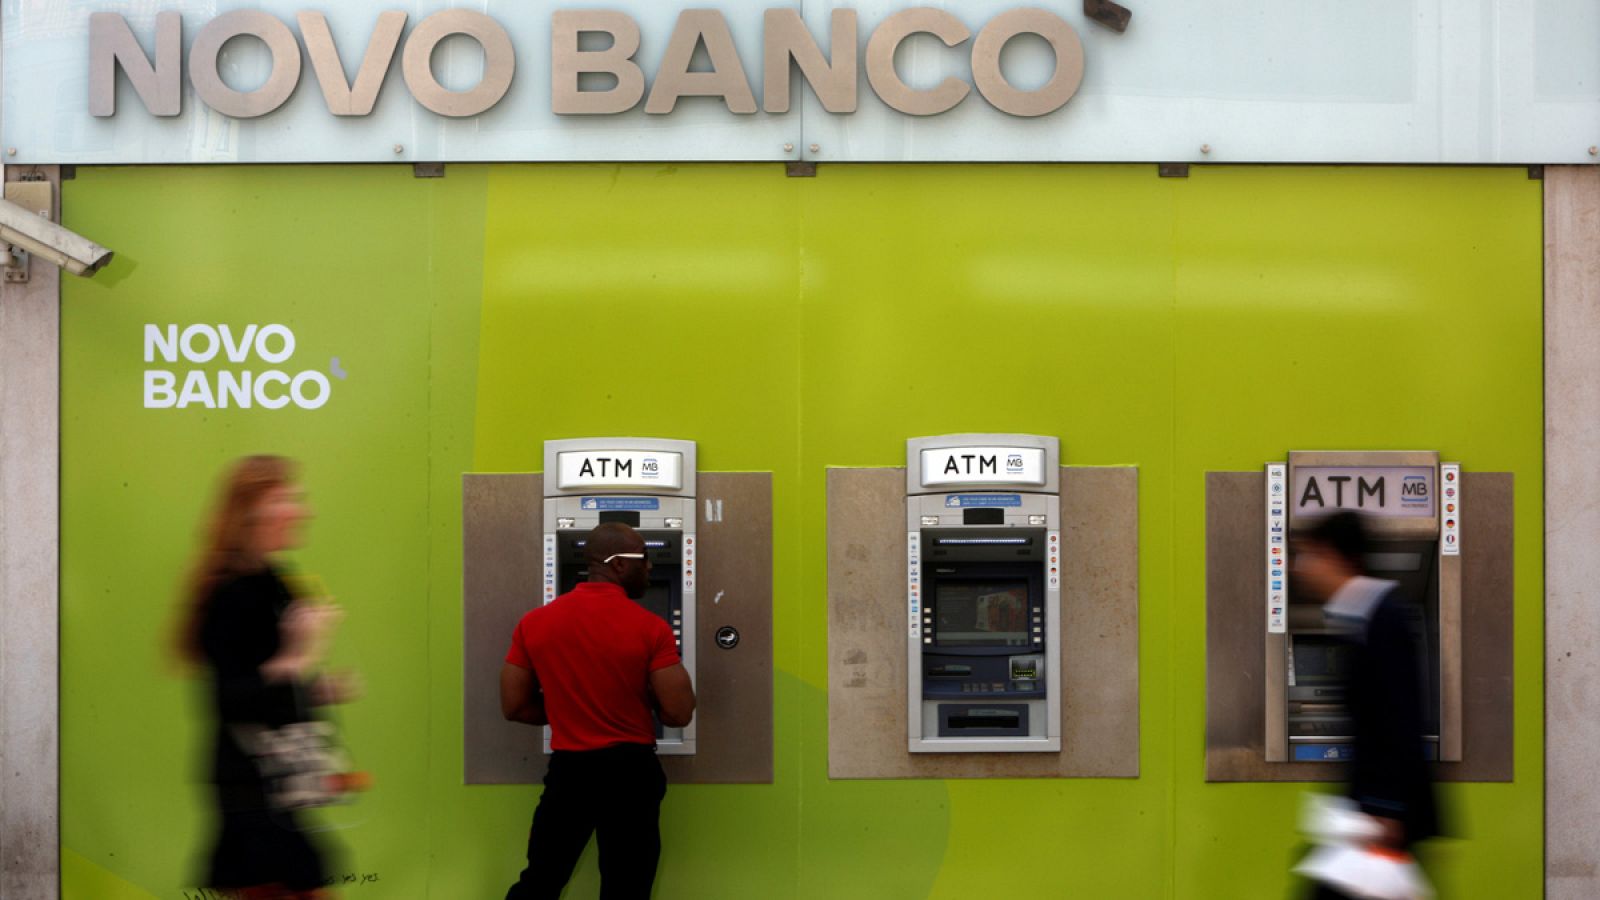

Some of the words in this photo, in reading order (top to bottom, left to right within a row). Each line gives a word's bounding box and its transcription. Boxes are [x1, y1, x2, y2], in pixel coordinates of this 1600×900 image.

[88, 8, 515, 118] NOVO
[551, 7, 1084, 116] BANCO
[144, 323, 296, 363] NOVO
[143, 370, 331, 409] BANCO
[579, 457, 632, 478] ATM
[944, 455, 997, 475] ATM
[1299, 475, 1385, 508] ATM
[1401, 482, 1428, 496] MB
